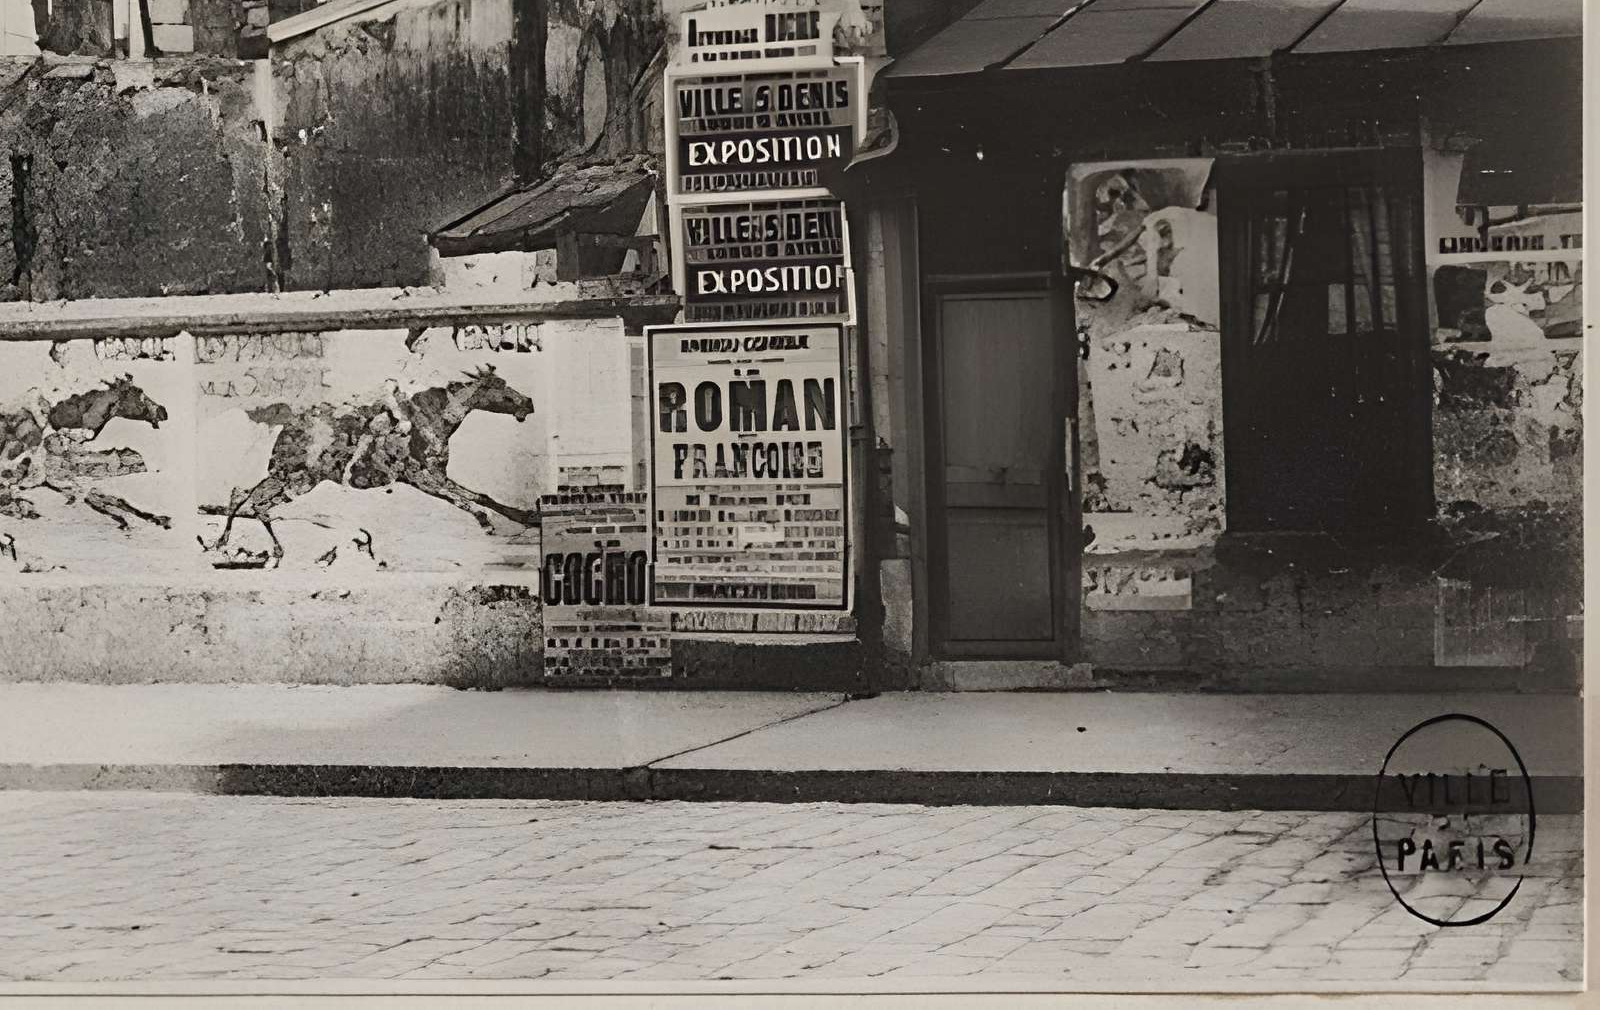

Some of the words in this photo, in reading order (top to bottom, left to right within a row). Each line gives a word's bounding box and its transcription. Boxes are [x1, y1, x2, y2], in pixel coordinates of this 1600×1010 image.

[680, 87, 743, 118] VILLE
[688, 133, 841, 167] EXPOSITION
[658, 377, 837, 433] ROMAN
